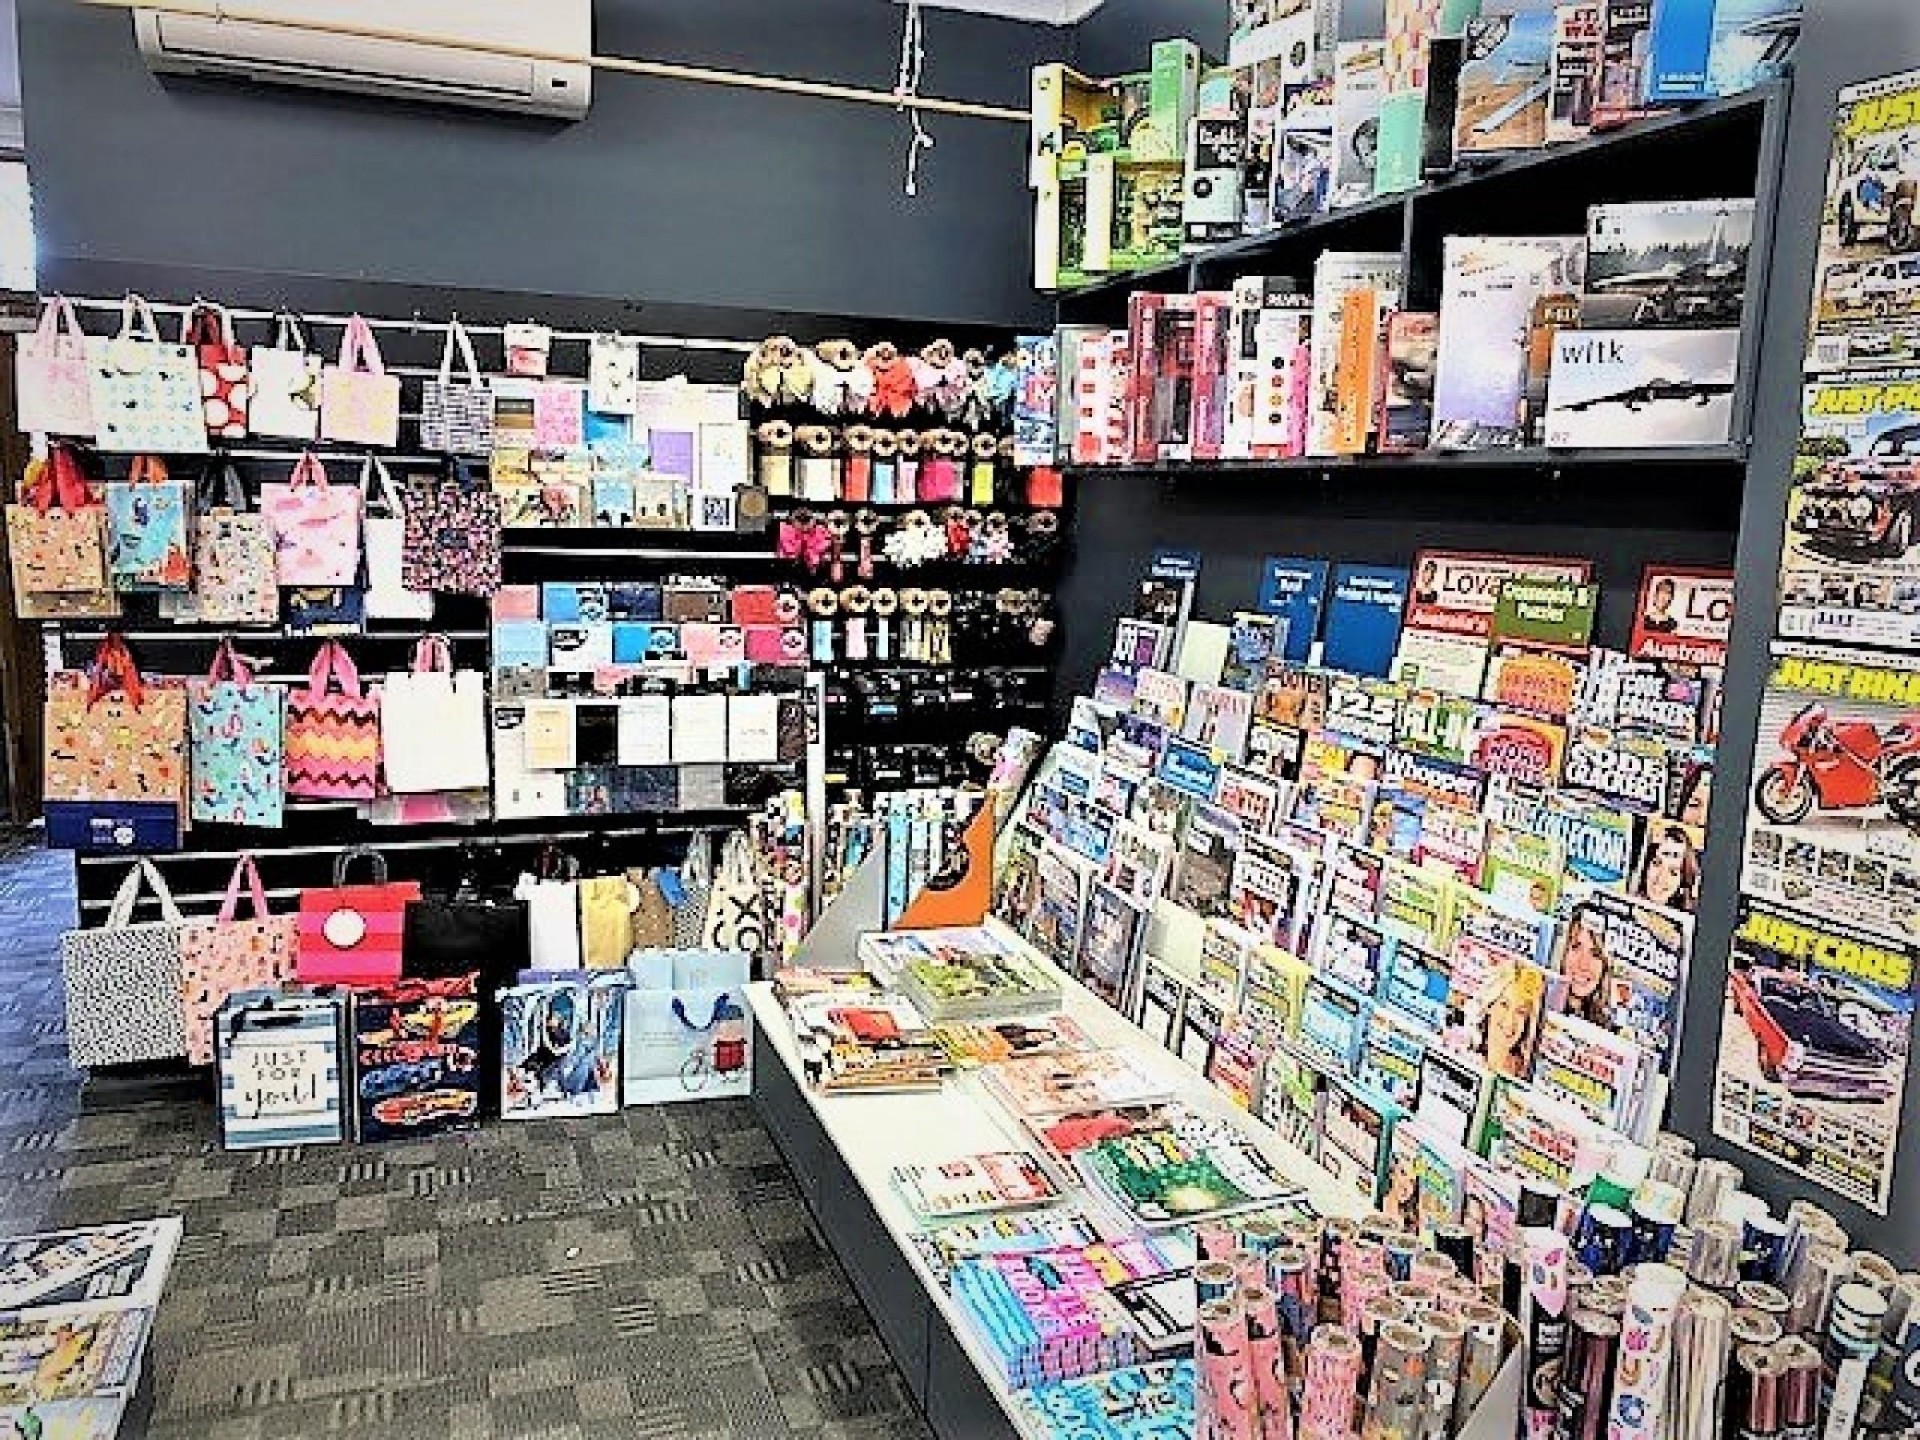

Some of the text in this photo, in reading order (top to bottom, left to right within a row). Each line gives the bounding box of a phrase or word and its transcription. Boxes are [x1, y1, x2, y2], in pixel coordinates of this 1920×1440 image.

[1778, 656, 1846, 693] JUST
[1385, 750, 1477, 795] Whopper
[1571, 744, 1665, 783] CODE
[1743, 910, 1813, 957] JUST
[1812, 931, 1912, 989] CARS
[251, 1049, 308, 1069] JUST
